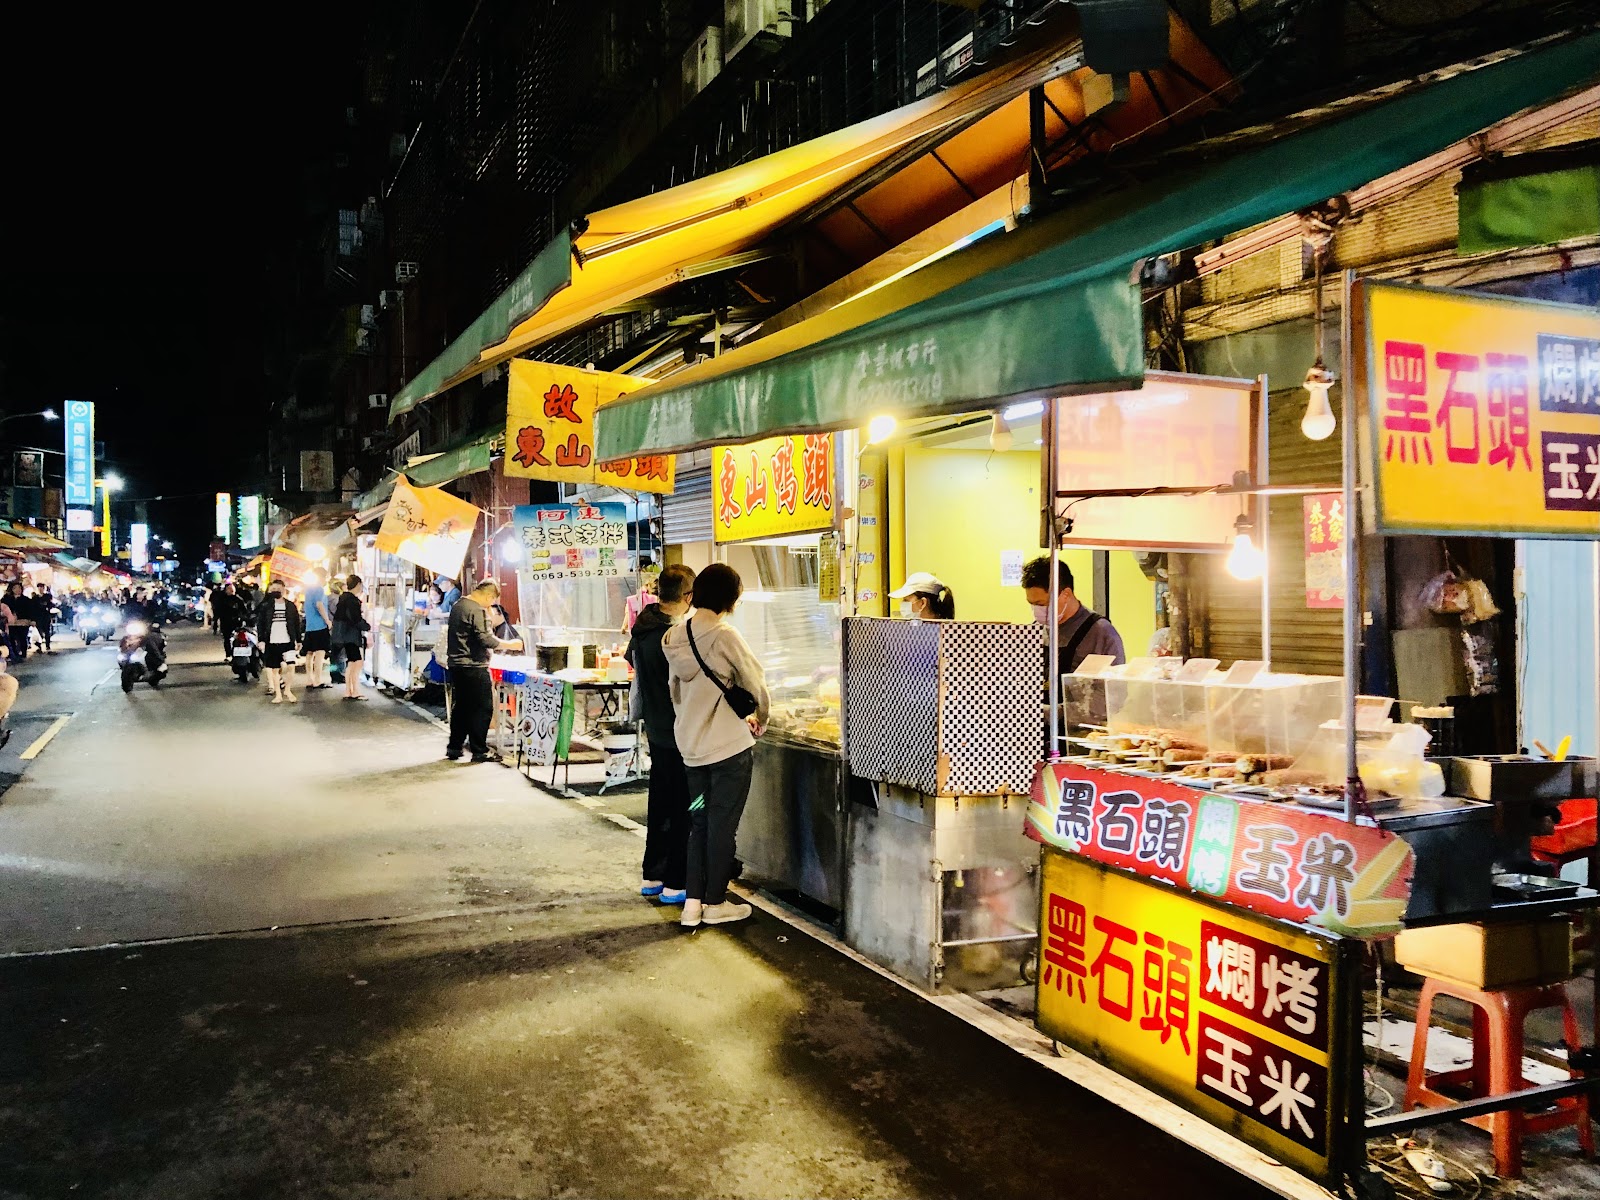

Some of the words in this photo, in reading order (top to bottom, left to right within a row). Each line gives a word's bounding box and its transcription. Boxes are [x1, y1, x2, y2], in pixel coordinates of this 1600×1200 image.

[1384, 340, 1533, 472] 黑石頭
[719, 432, 833, 529] 東山鴨頭
[533, 568, 618, 581] 0963-539-233
[1055, 780, 1191, 870] 黑石頭
[1237, 825, 1356, 918] 玉米
[1044, 893, 1193, 1057] 黑石頭
[1205, 936, 1320, 1035] 燜烤
[1202, 1027, 1316, 1140] 玉米
